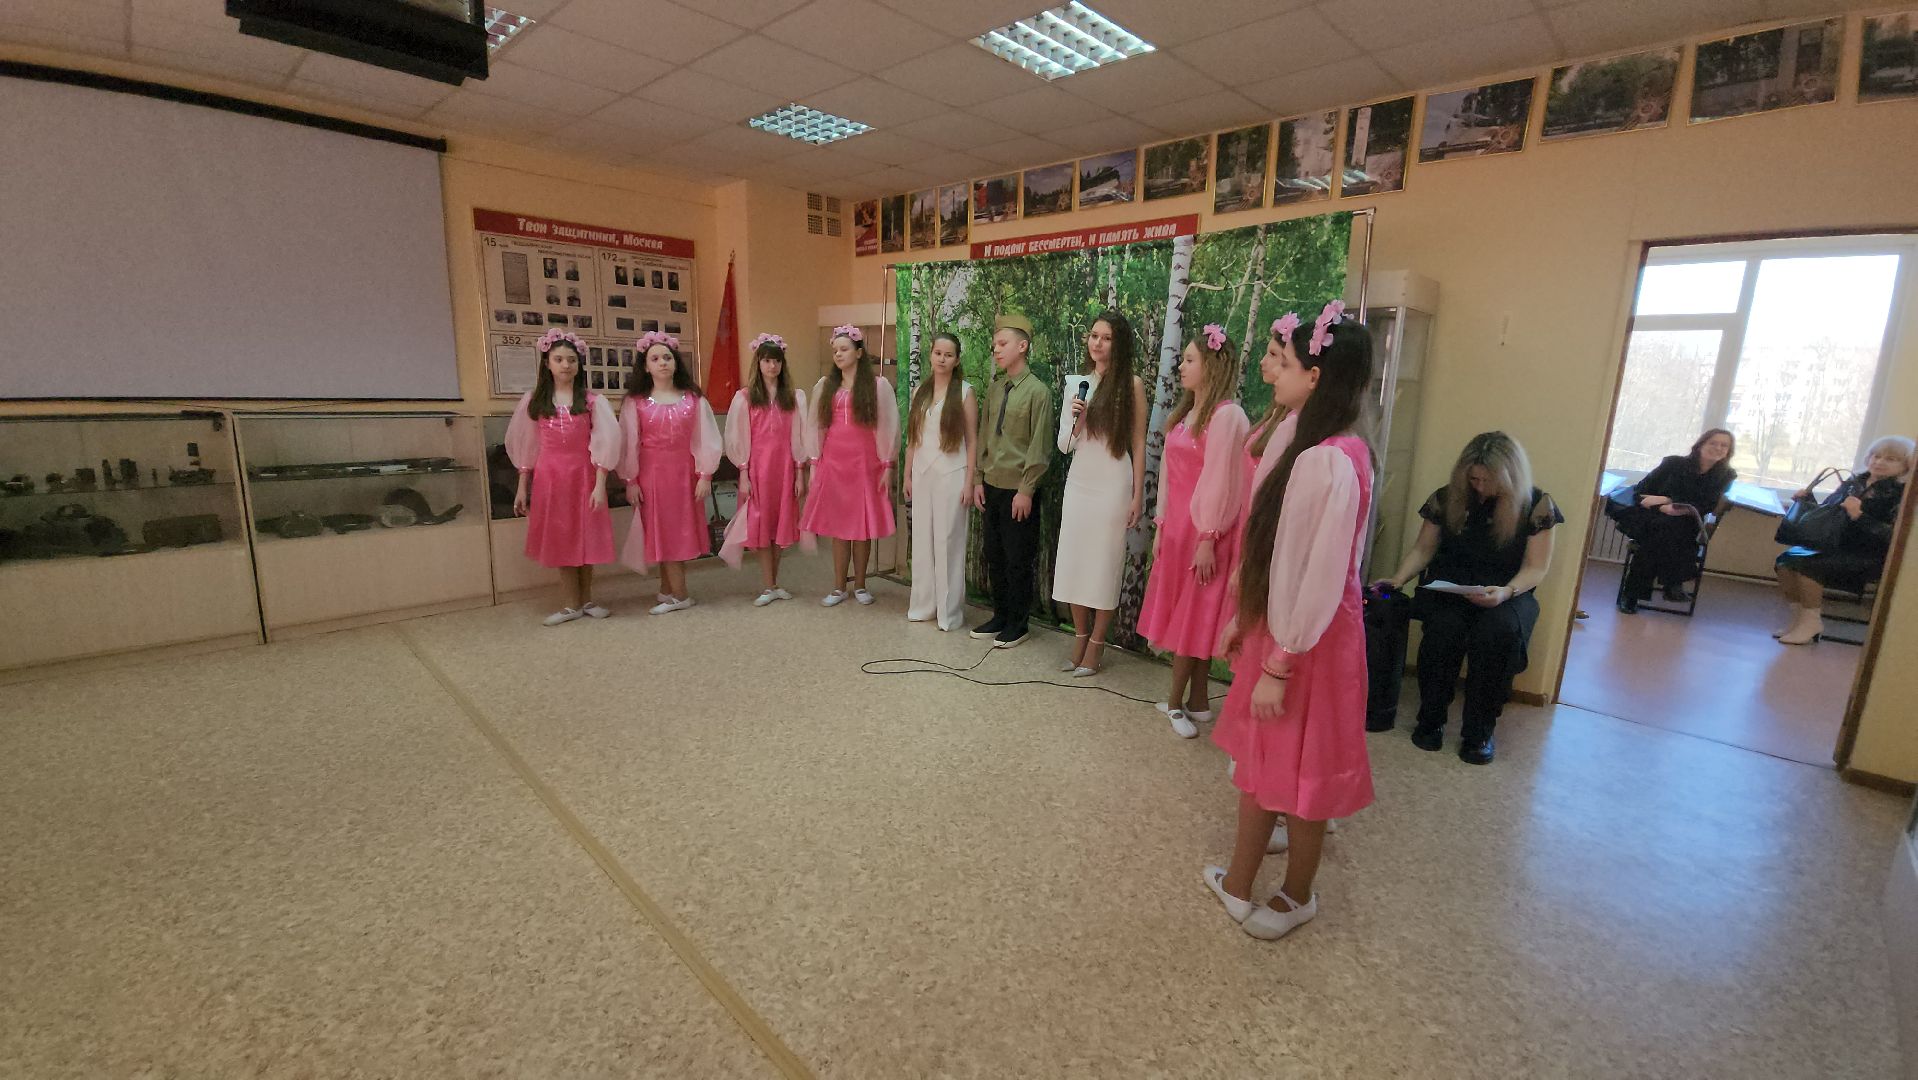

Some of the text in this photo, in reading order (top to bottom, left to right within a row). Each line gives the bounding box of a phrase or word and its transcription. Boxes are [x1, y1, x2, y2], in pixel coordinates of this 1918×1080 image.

[484, 237, 497, 247] 15
[984, 245, 992, 257] И
[1088, 233, 1097, 245] И
[602, 252, 618, 262] 172
[502, 335, 521, 345] 352
